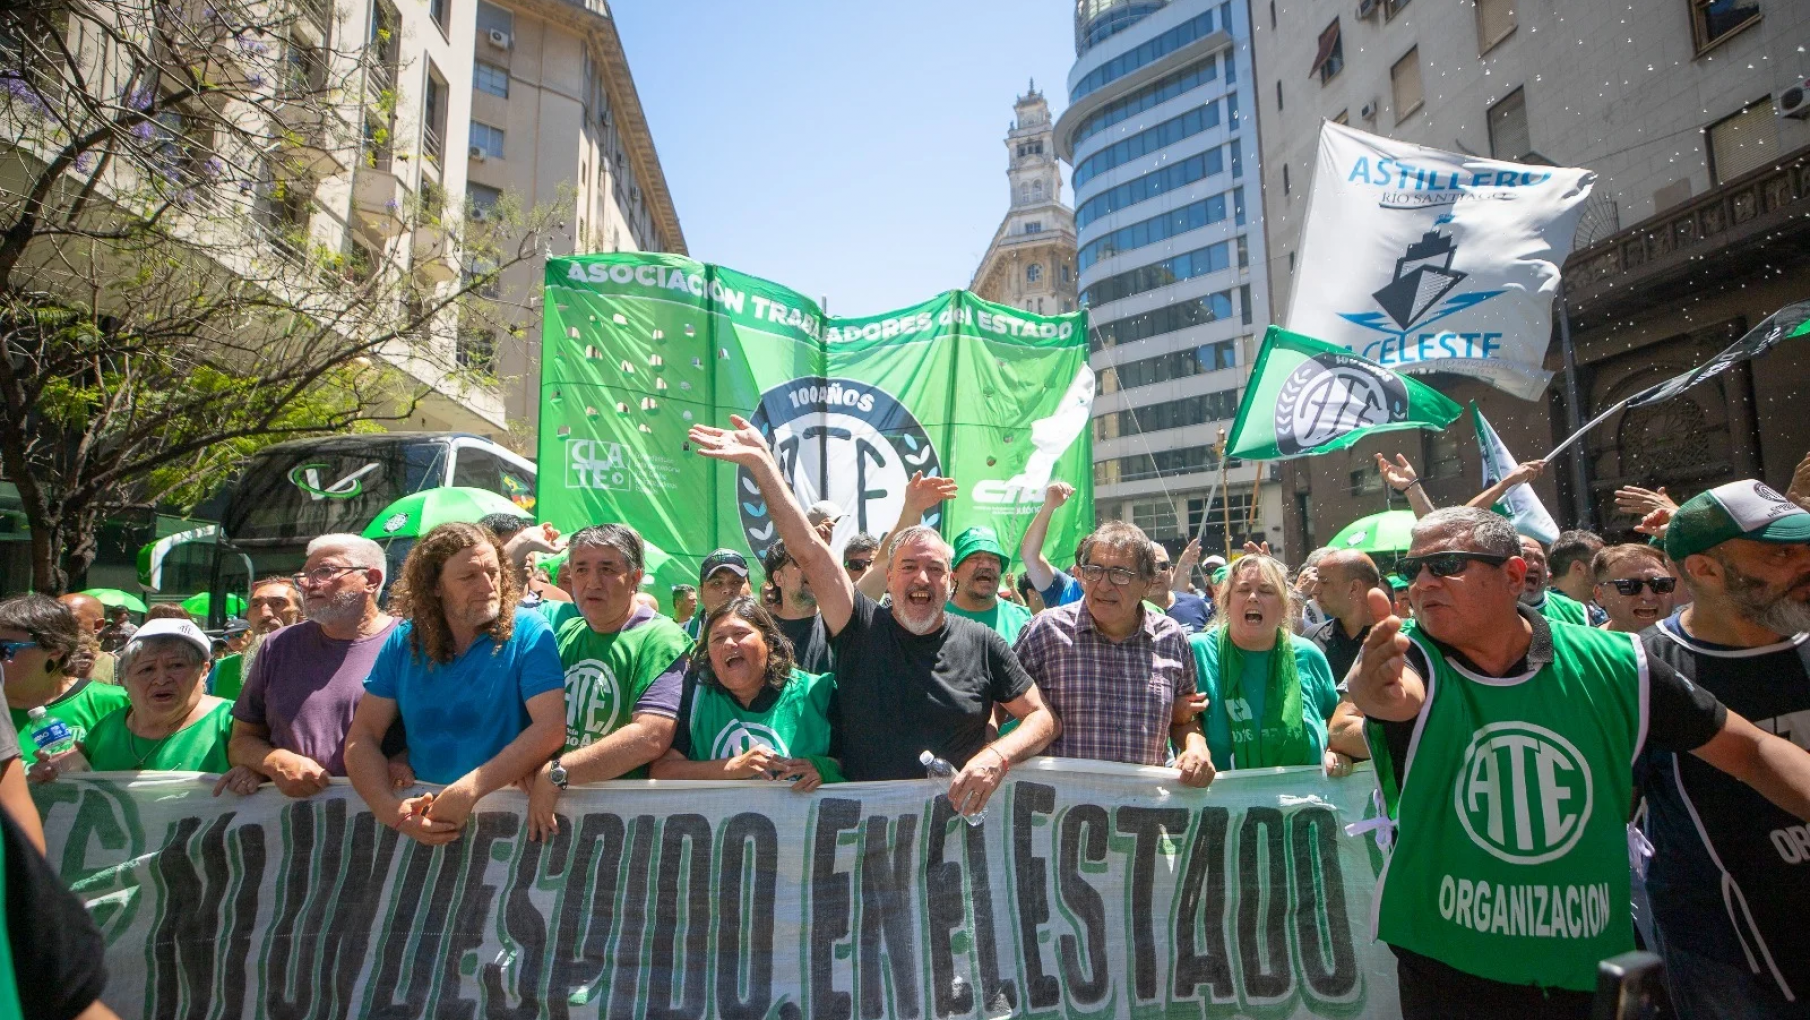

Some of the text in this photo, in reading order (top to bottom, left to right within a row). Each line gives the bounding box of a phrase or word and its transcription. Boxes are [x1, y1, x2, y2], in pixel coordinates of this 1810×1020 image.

[1348, 155, 1553, 191] ASTILLERO
[568, 262, 1073, 344] ASOCIACIÓN TRABAJADORES del ESTADO
[817, 383, 875, 412] AÑOS
[1467, 734, 1577, 851] ATE
[1769, 823, 1810, 865] OR
[811, 797, 920, 1020] EN
[1013, 779, 1357, 1008] ESTADO
[1438, 874, 1611, 939] ORGANIZACION
